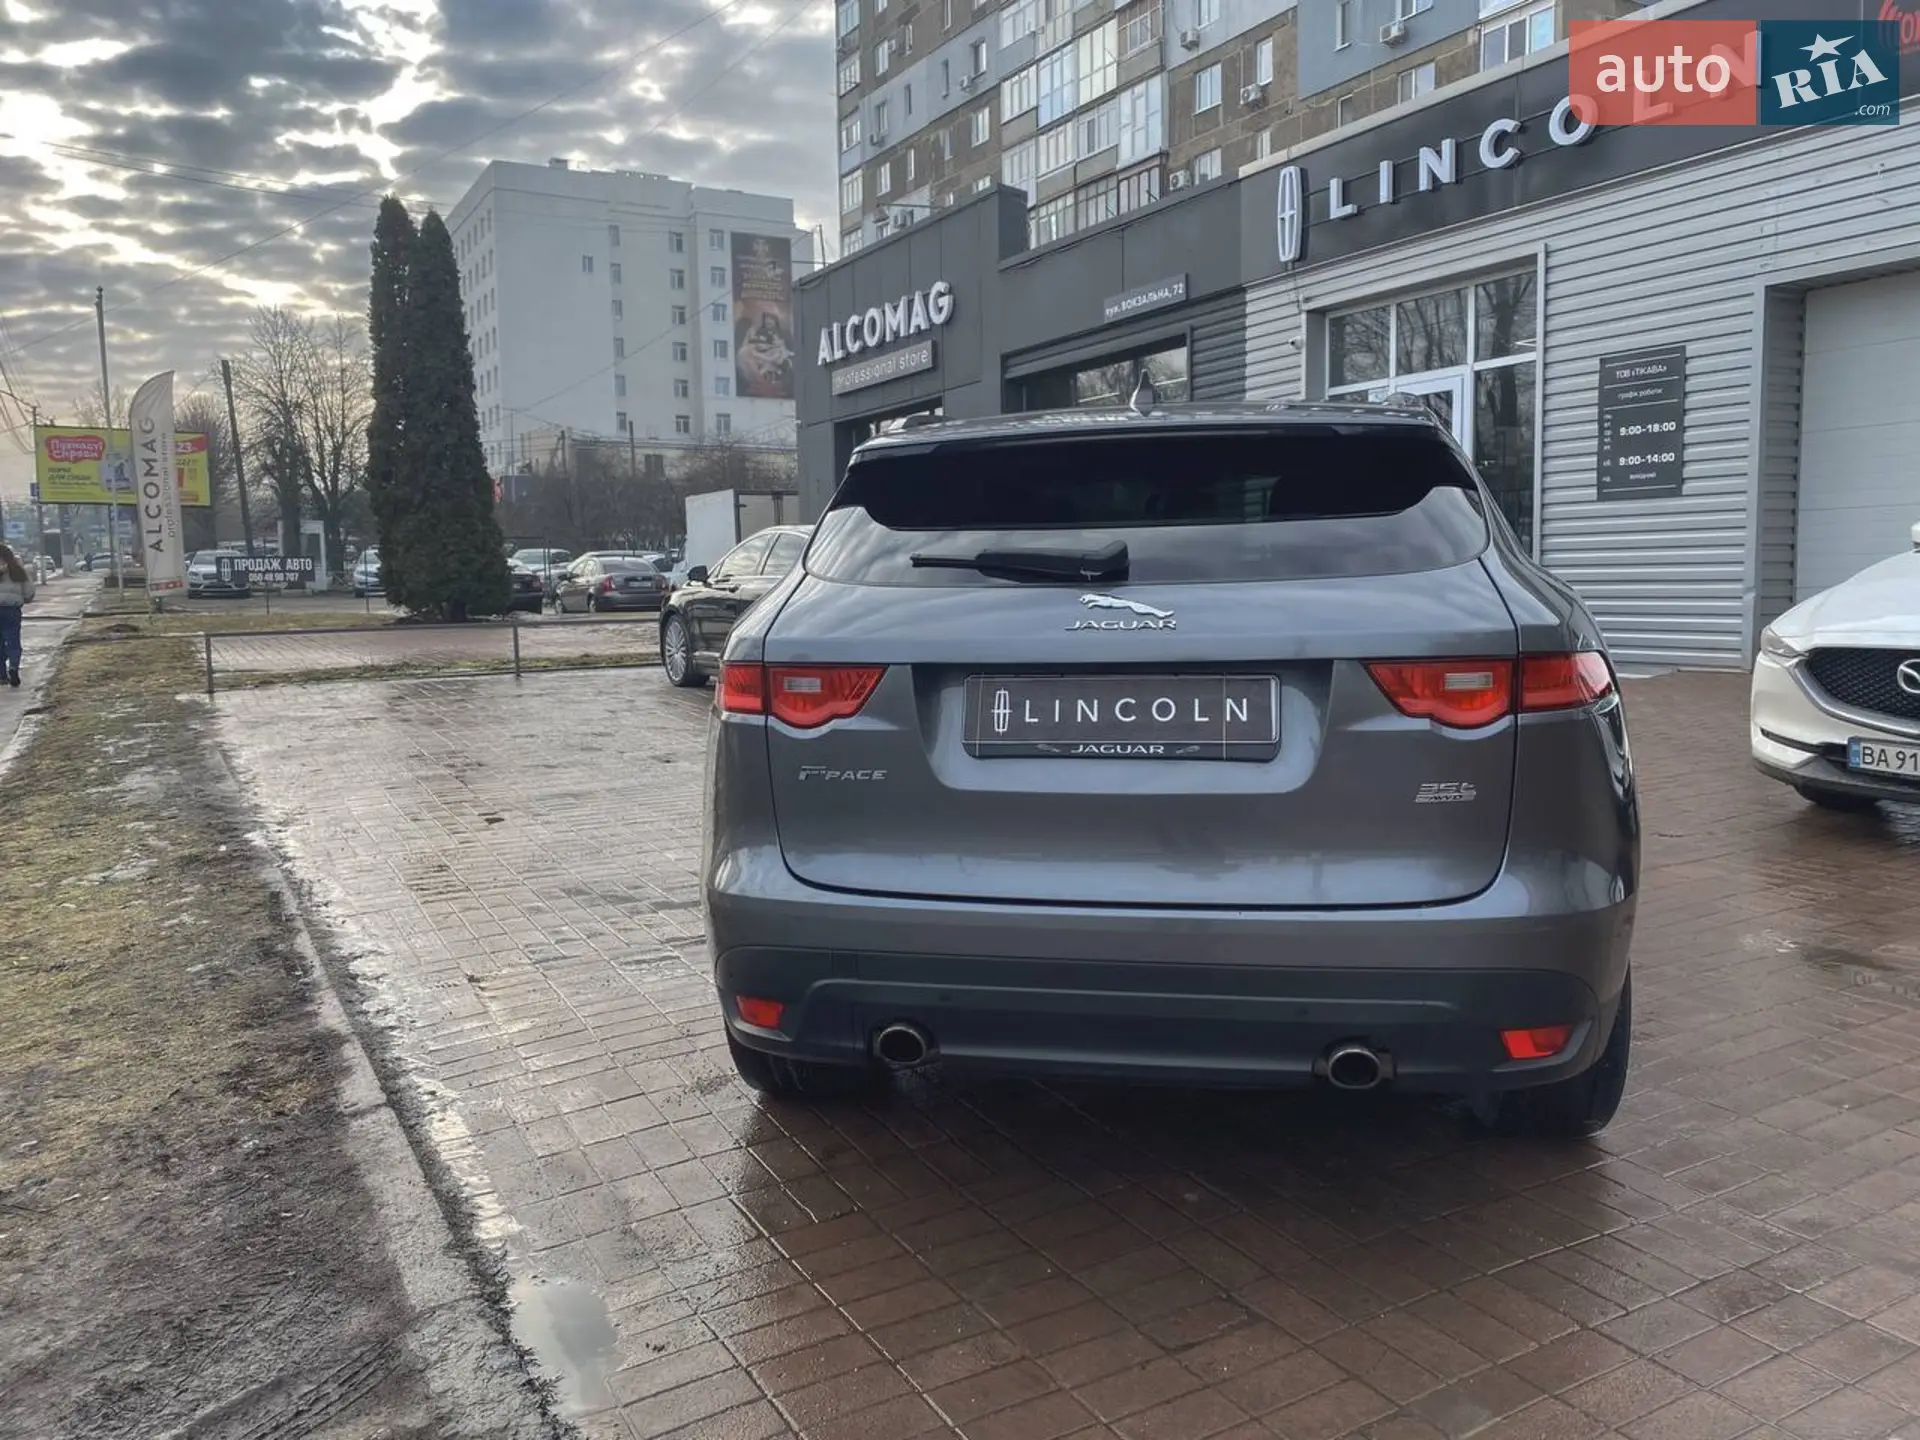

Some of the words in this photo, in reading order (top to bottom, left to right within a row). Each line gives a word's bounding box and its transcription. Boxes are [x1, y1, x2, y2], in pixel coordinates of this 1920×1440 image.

[1329, 28, 1762, 221] LINCOLN
[1173, 282, 1184, 295] 72
[817, 281, 954, 366] ALCOMAG
[834, 356, 898, 389] professional
[899, 349, 929, 370] store
[139, 416, 164, 553] ALCOMAG
[234, 558, 281, 571] ПРОДАЖ
[286, 558, 313, 571] АВТО
[1064, 619, 1177, 631] JAGUAR
[1025, 698, 1248, 723] LINCOLN
[1070, 743, 1165, 755] JAGUAR
[1862, 746, 1889, 768] BA
